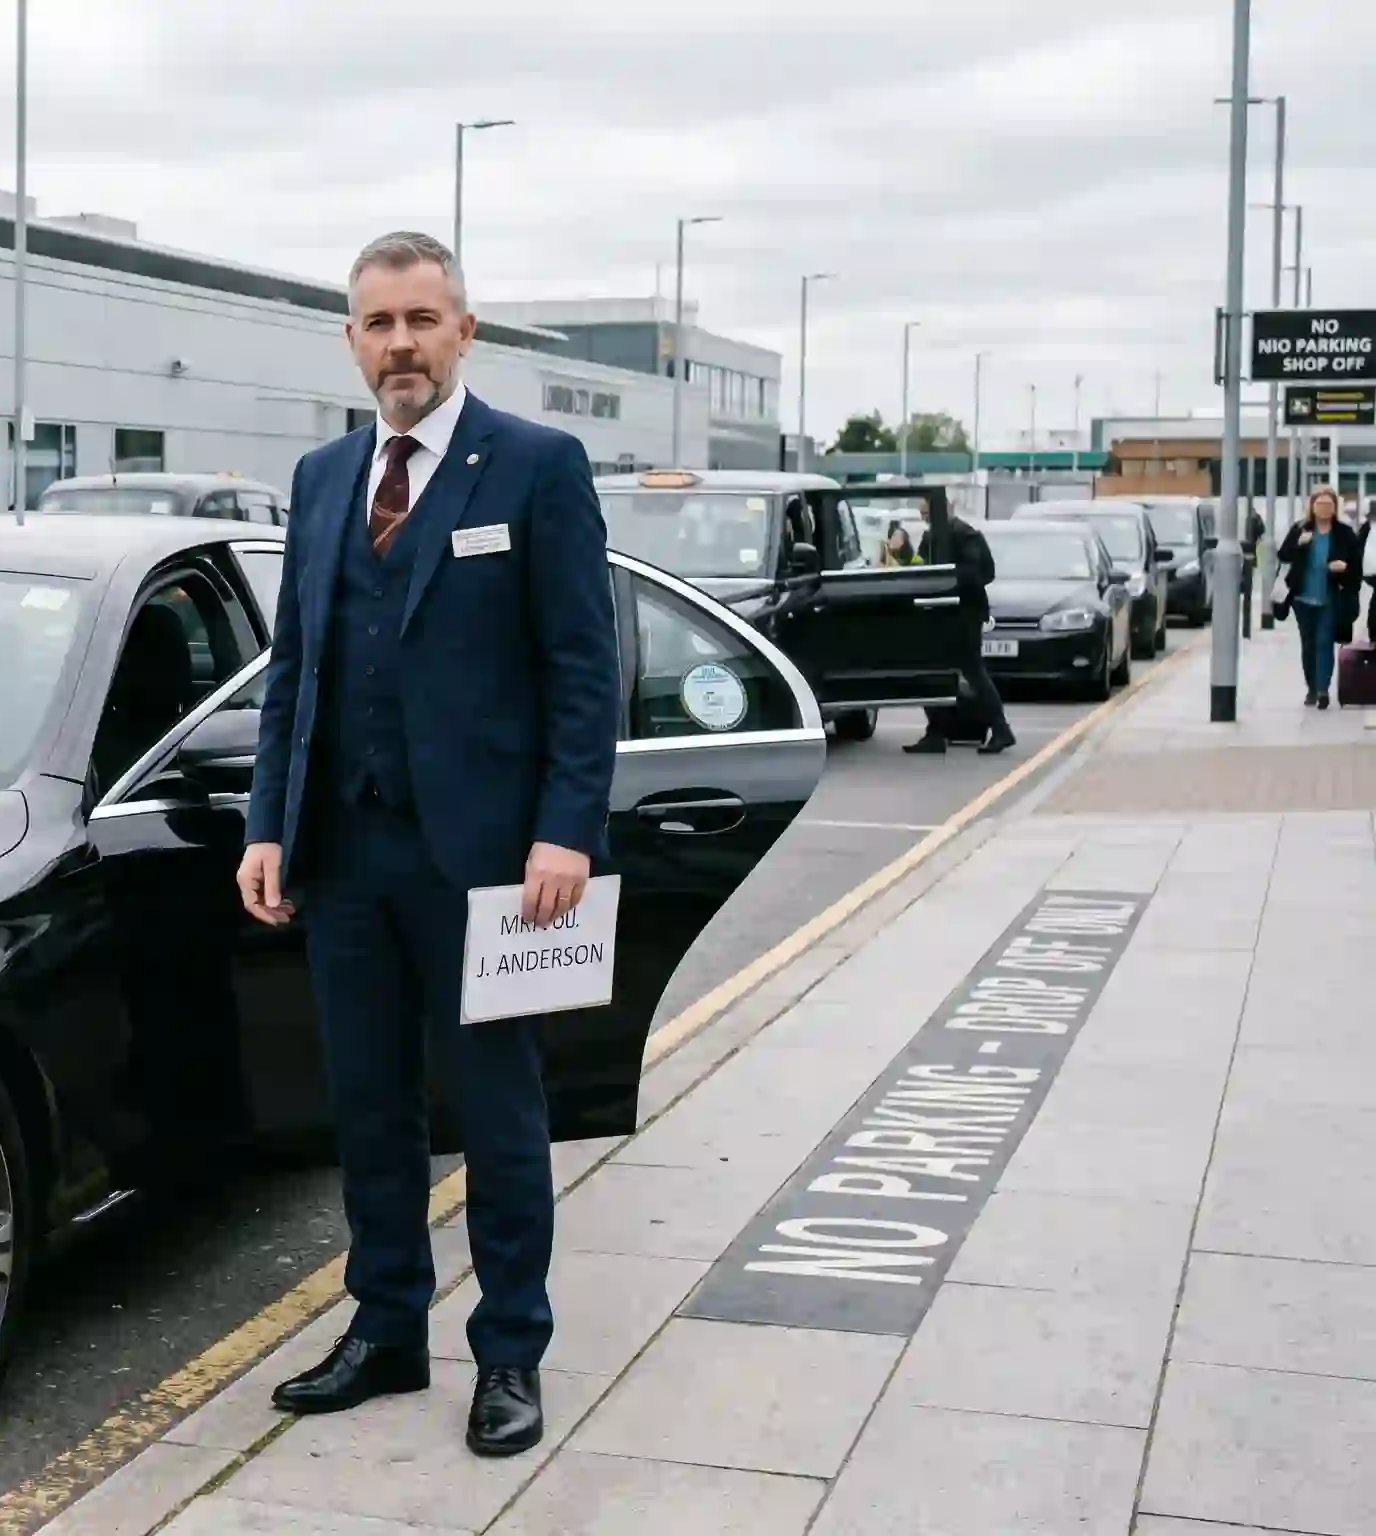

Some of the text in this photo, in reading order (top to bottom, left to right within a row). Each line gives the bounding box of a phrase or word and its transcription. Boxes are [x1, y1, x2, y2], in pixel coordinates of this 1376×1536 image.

[1311, 319, 1340, 334] NO
[1258, 337, 1373, 354] NIO PARKING
[1282, 356, 1366, 372] SHOP OFF
[476, 942, 604, 978] J. ANDERSON
[995, 936, 1113, 972] OFF
[944, 977, 1091, 1034] DROP
[805, 1064, 1043, 1202] PARKING
[743, 1217, 949, 1285] NO
